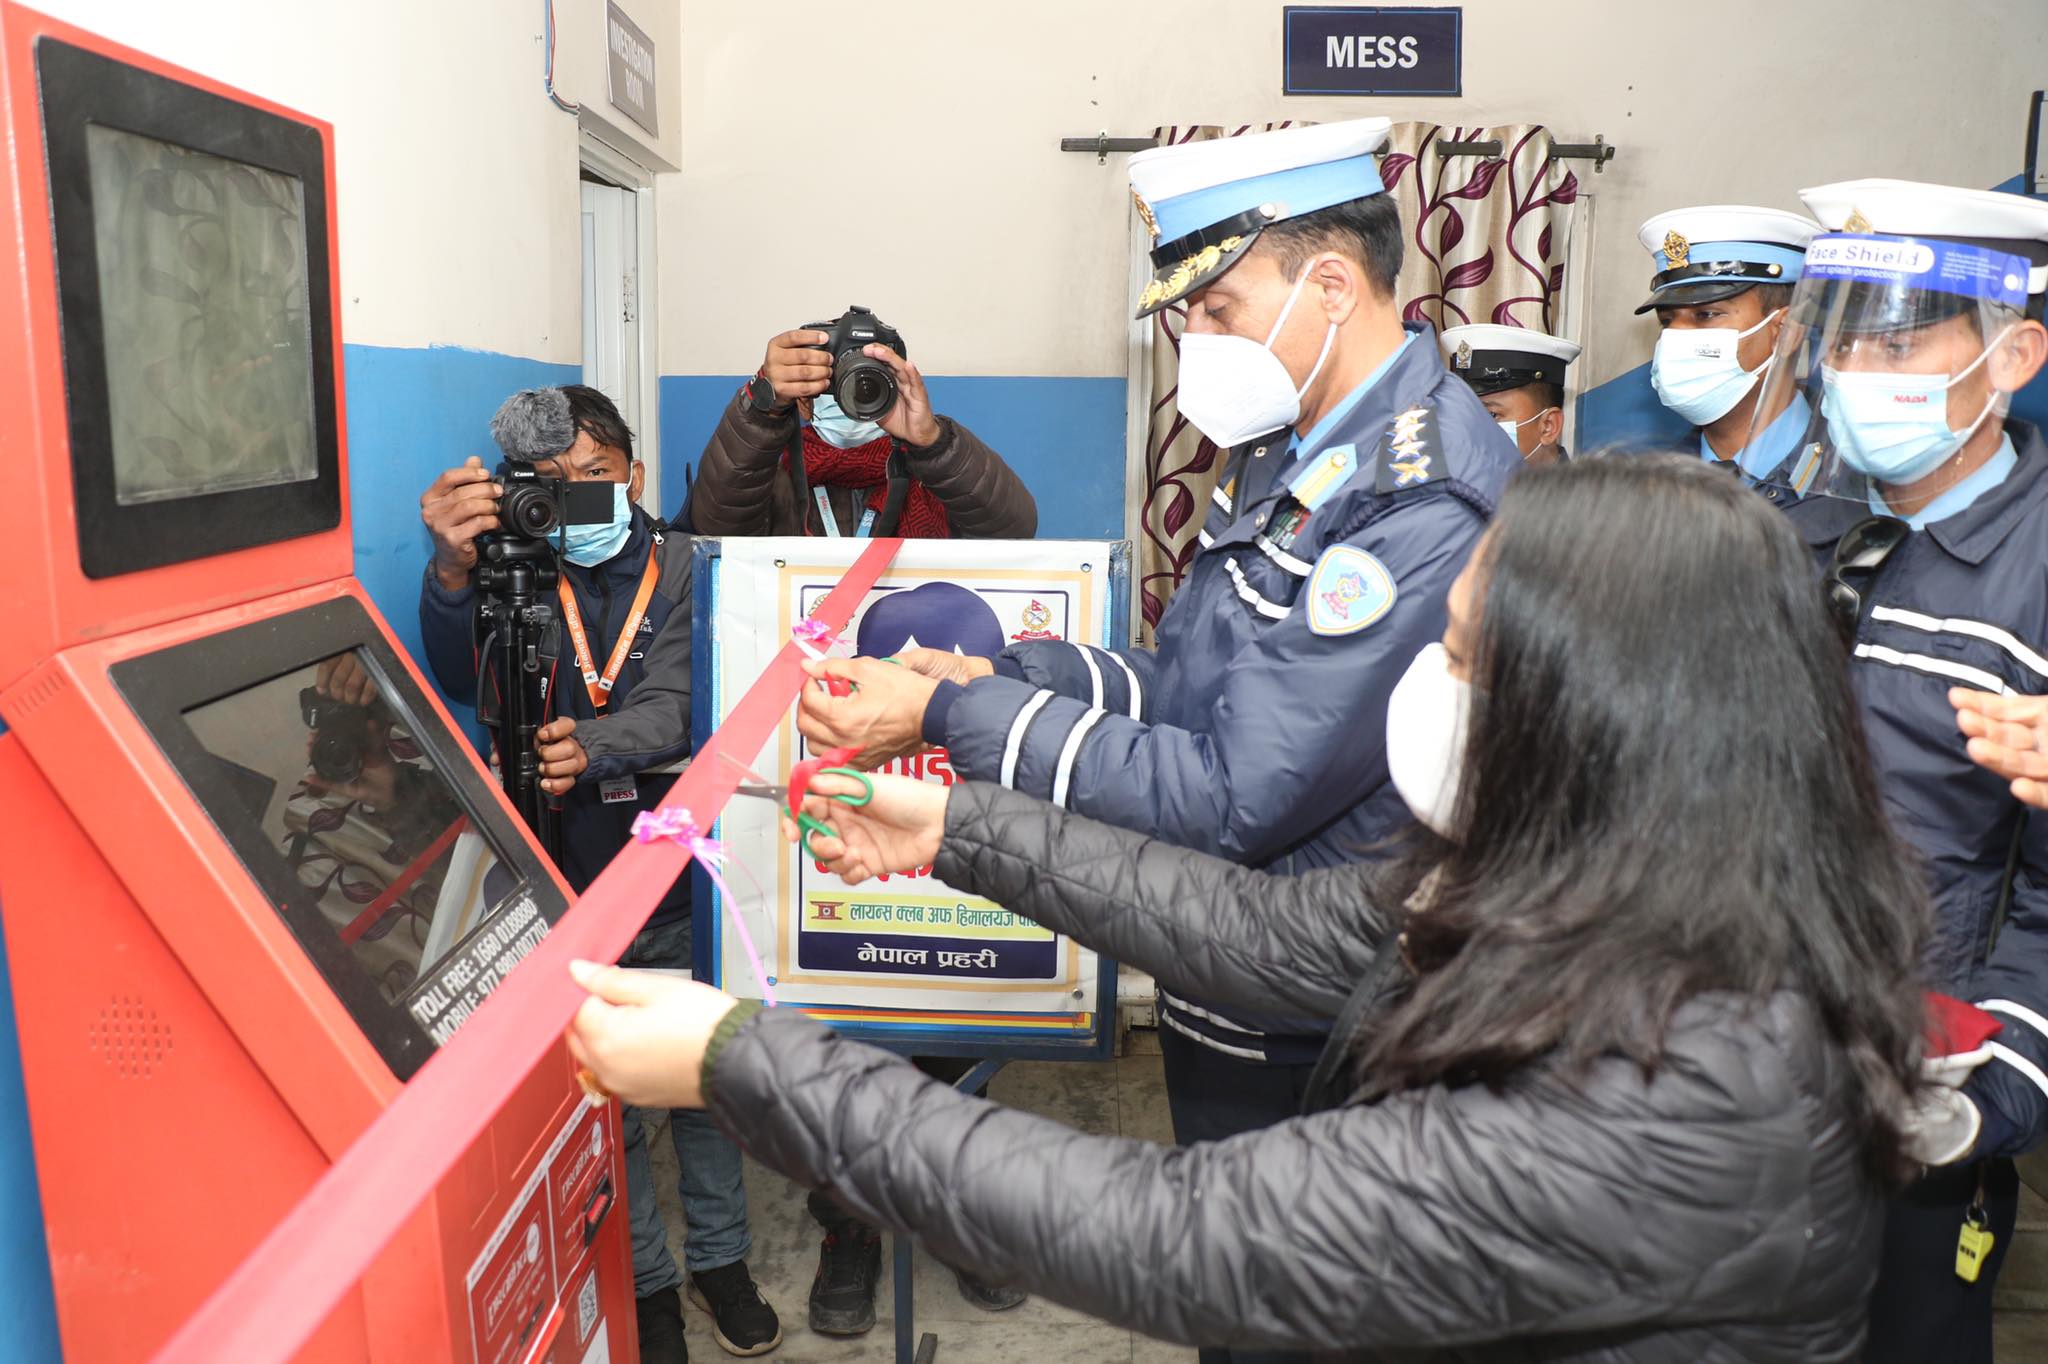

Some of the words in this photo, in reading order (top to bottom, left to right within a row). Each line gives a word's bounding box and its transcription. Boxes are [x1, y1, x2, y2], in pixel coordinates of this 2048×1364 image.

[610, 17, 654, 86] INVESTIGATION
[1326, 35, 1419, 69] MESS
[625, 66, 645, 112] ROOM
[1845, 244, 1920, 267] Shield
[604, 790, 635, 800] PRESS
[850, 903, 893, 922] लायन्स
[896, 905, 925, 922] क्लब
[928, 907, 953, 924] अफ
[857, 942, 929, 965] नेपाल
[936, 948, 999, 969] प्रहरी
[412, 985, 451, 1025] TOLL
[442, 957, 480, 997] FREE:
[472, 934, 502, 968] 1660
[476, 968, 500, 997] 977
